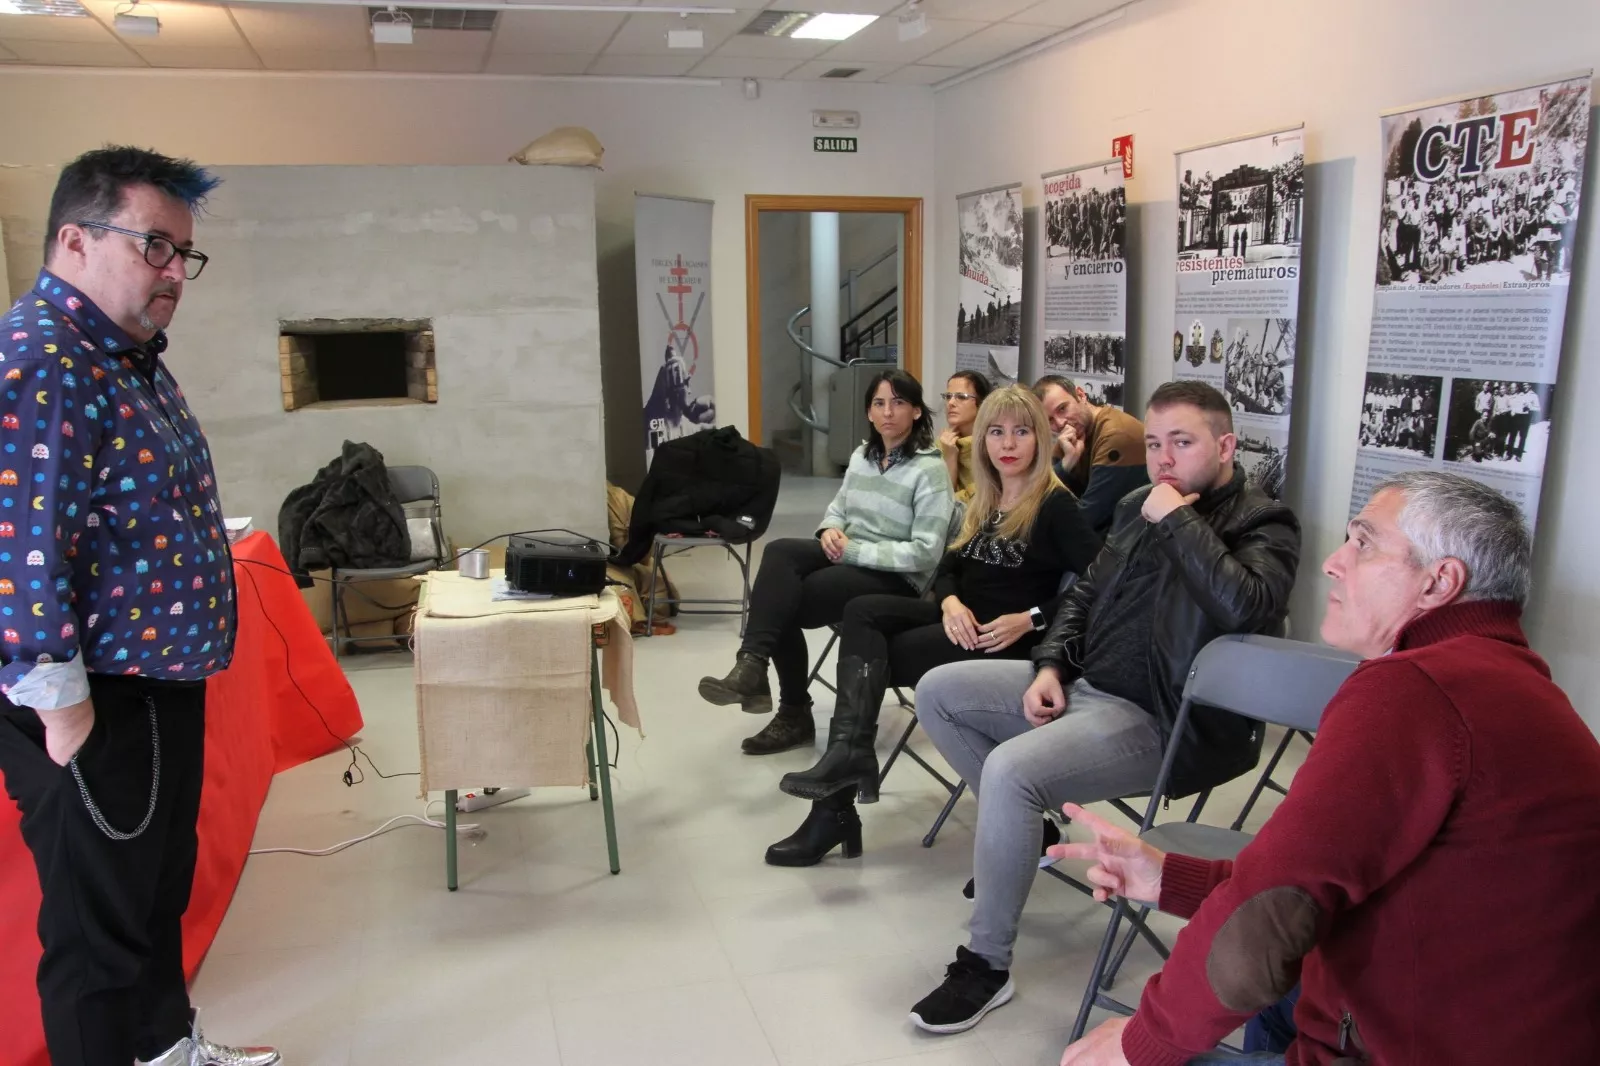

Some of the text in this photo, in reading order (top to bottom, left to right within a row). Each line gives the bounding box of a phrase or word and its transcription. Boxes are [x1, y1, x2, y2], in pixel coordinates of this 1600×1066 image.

[816, 139, 855, 151] SALIDA
[1414, 108, 1540, 182] CTE
[1064, 261, 1123, 281] y encierro
[1212, 266, 1298, 286] prematuros
[1418, 283, 1461, 292] Trabajadores
[1503, 281, 1551, 290] Extranjeros
